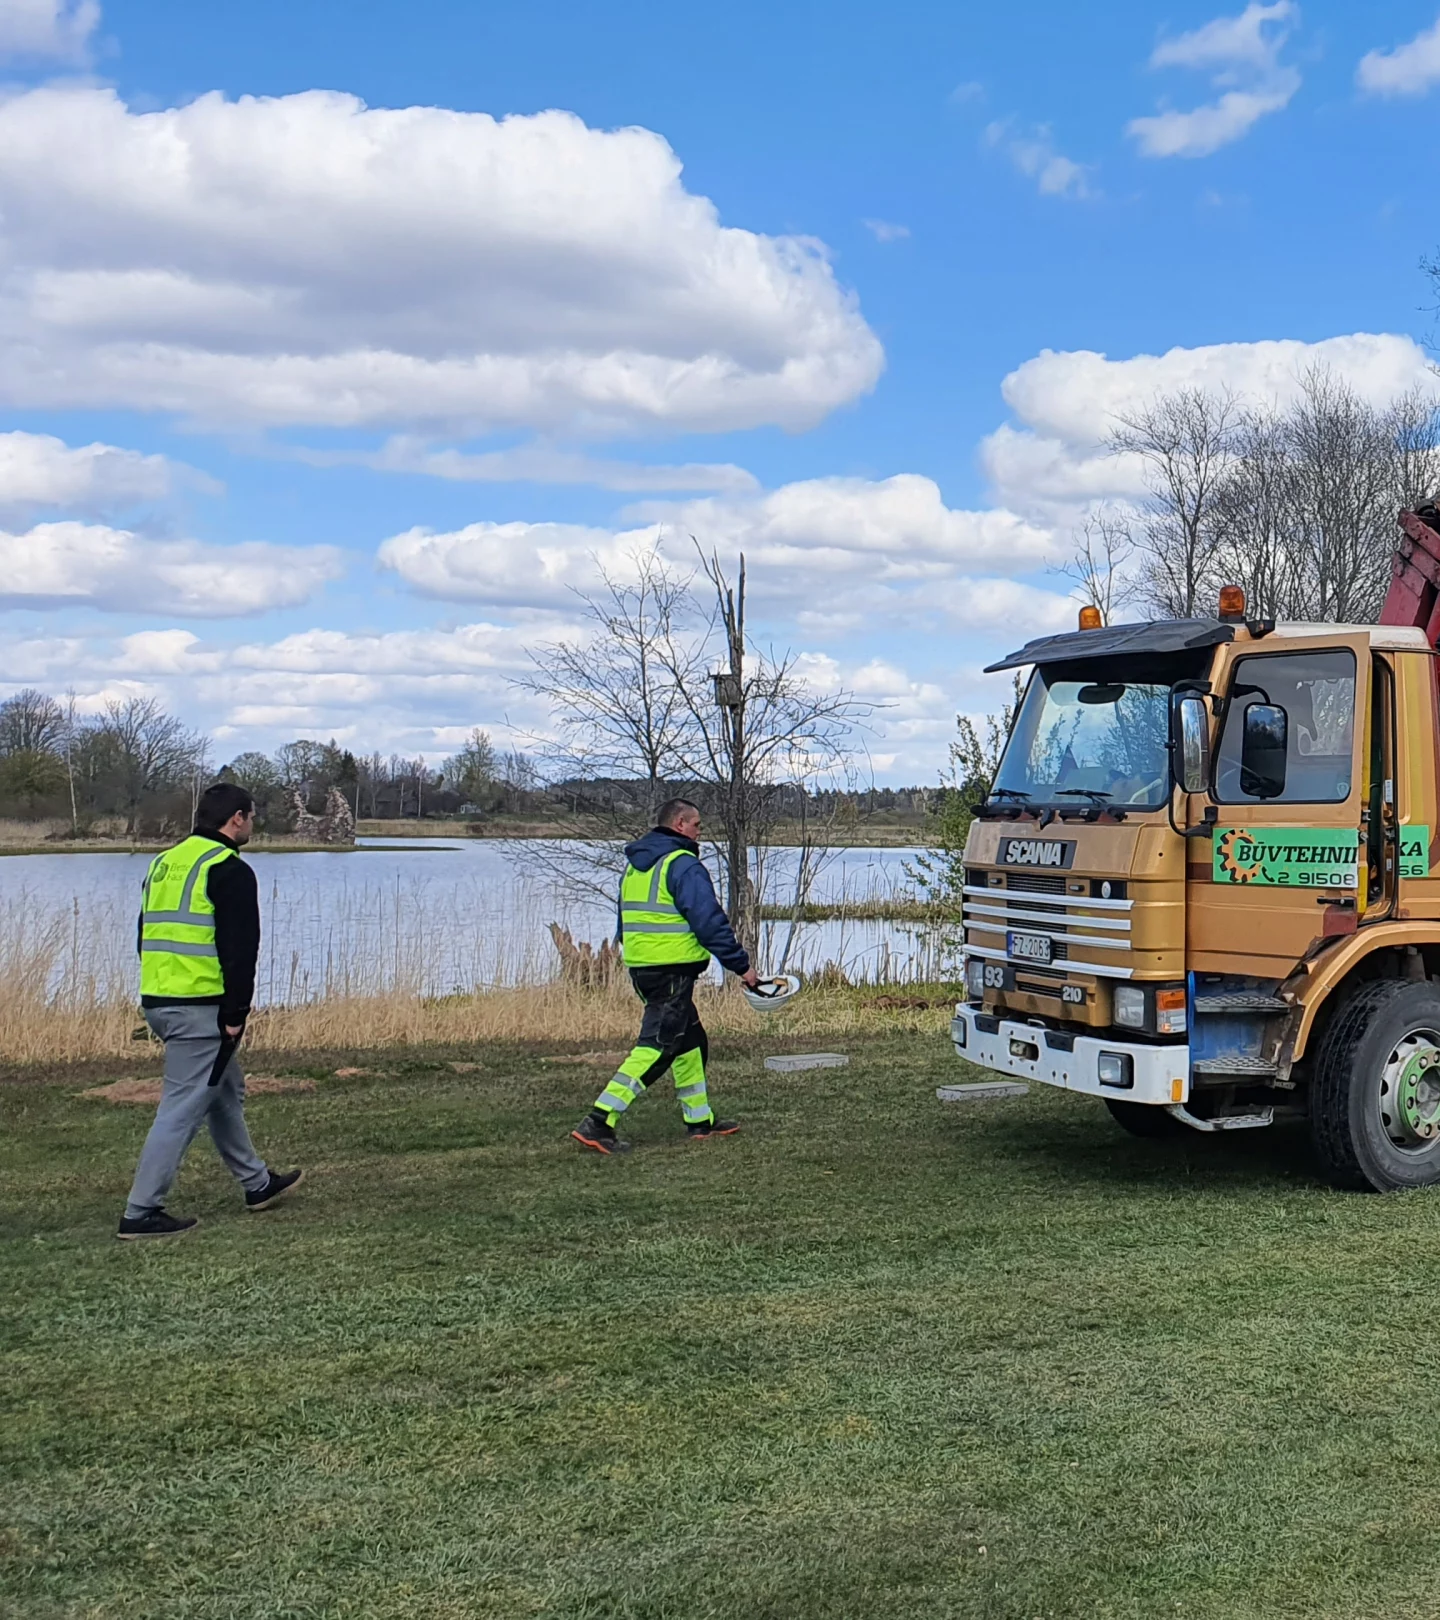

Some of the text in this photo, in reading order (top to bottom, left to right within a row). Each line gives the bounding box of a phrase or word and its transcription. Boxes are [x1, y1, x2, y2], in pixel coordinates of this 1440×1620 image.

[1006, 840, 1062, 866] SCANIA
[1277, 872, 1290, 884] 2
[1298, 873, 1355, 885] 91508
[985, 966, 1004, 988] 93
[1062, 986, 1083, 1002] 210
